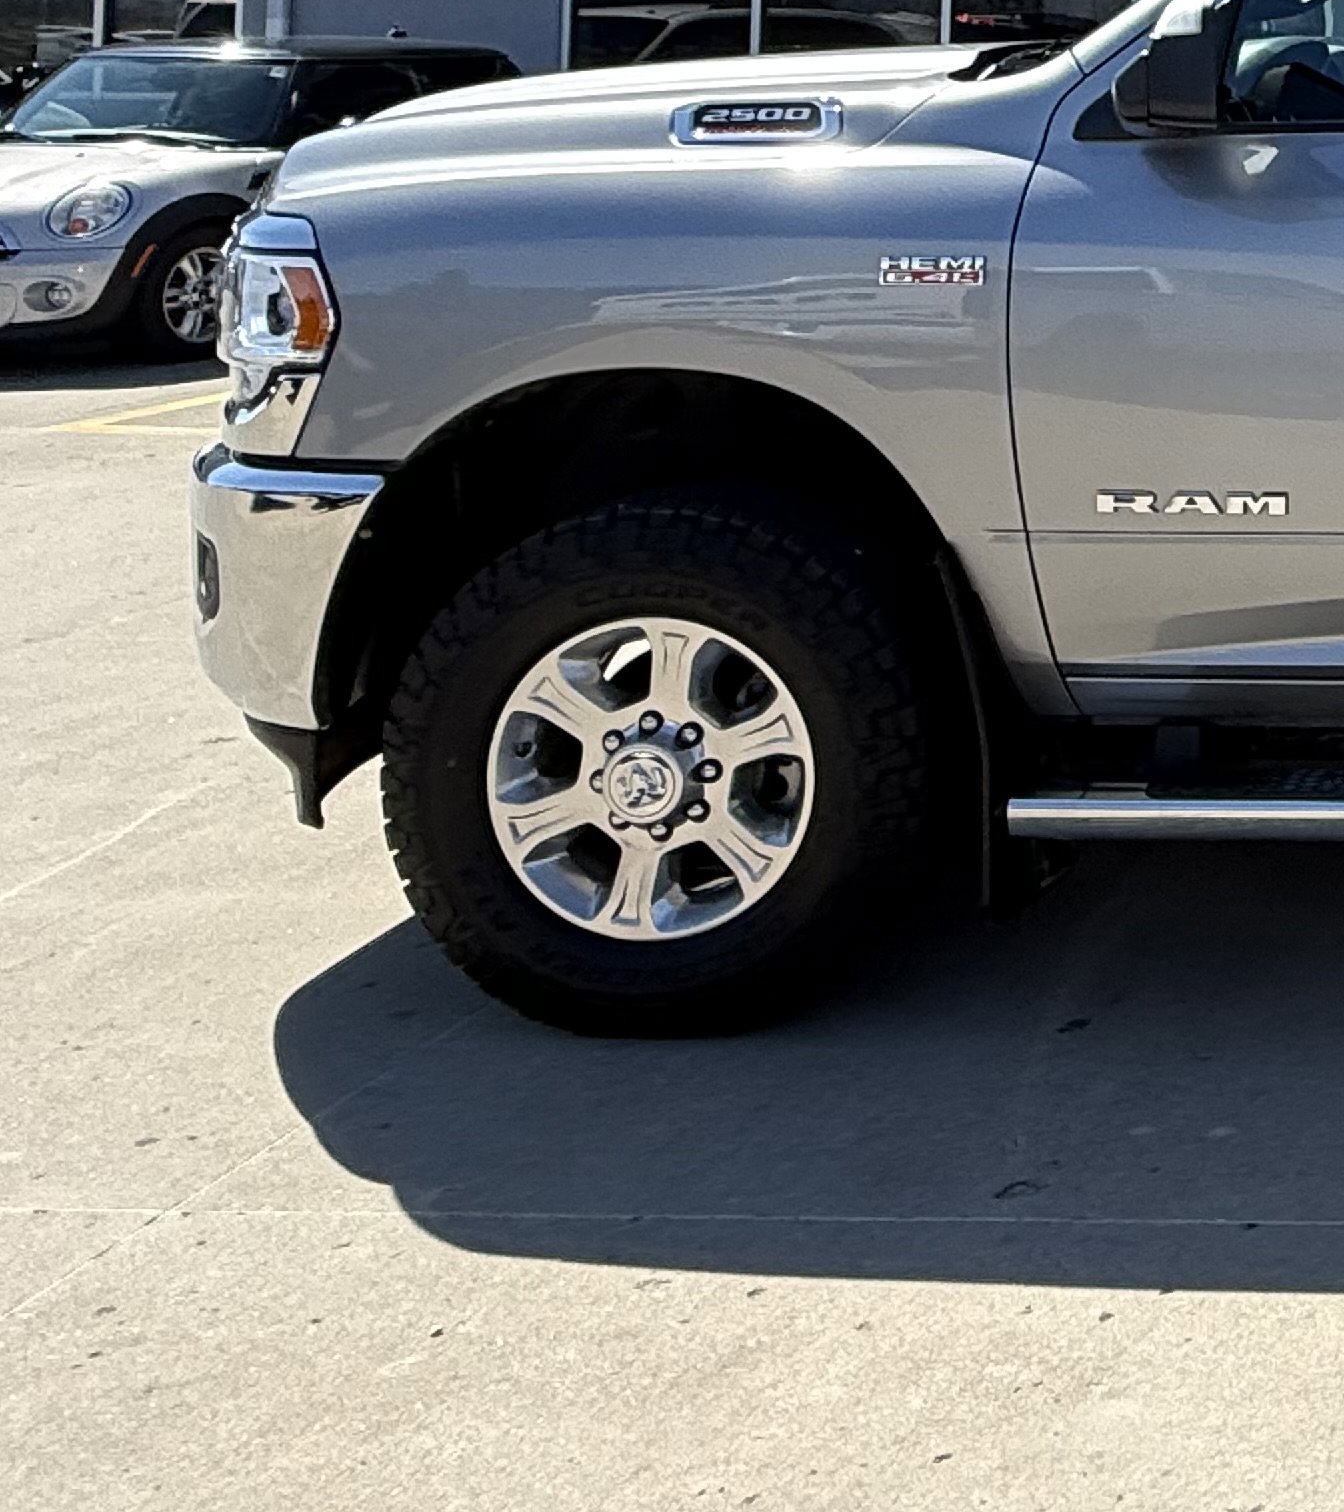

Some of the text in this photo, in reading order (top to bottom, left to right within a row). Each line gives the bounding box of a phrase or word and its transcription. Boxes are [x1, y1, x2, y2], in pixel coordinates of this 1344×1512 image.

[701, 107, 811, 123] 2500
[880, 256, 985, 270] HEMI
[1096, 489, 1290, 516] RAM
